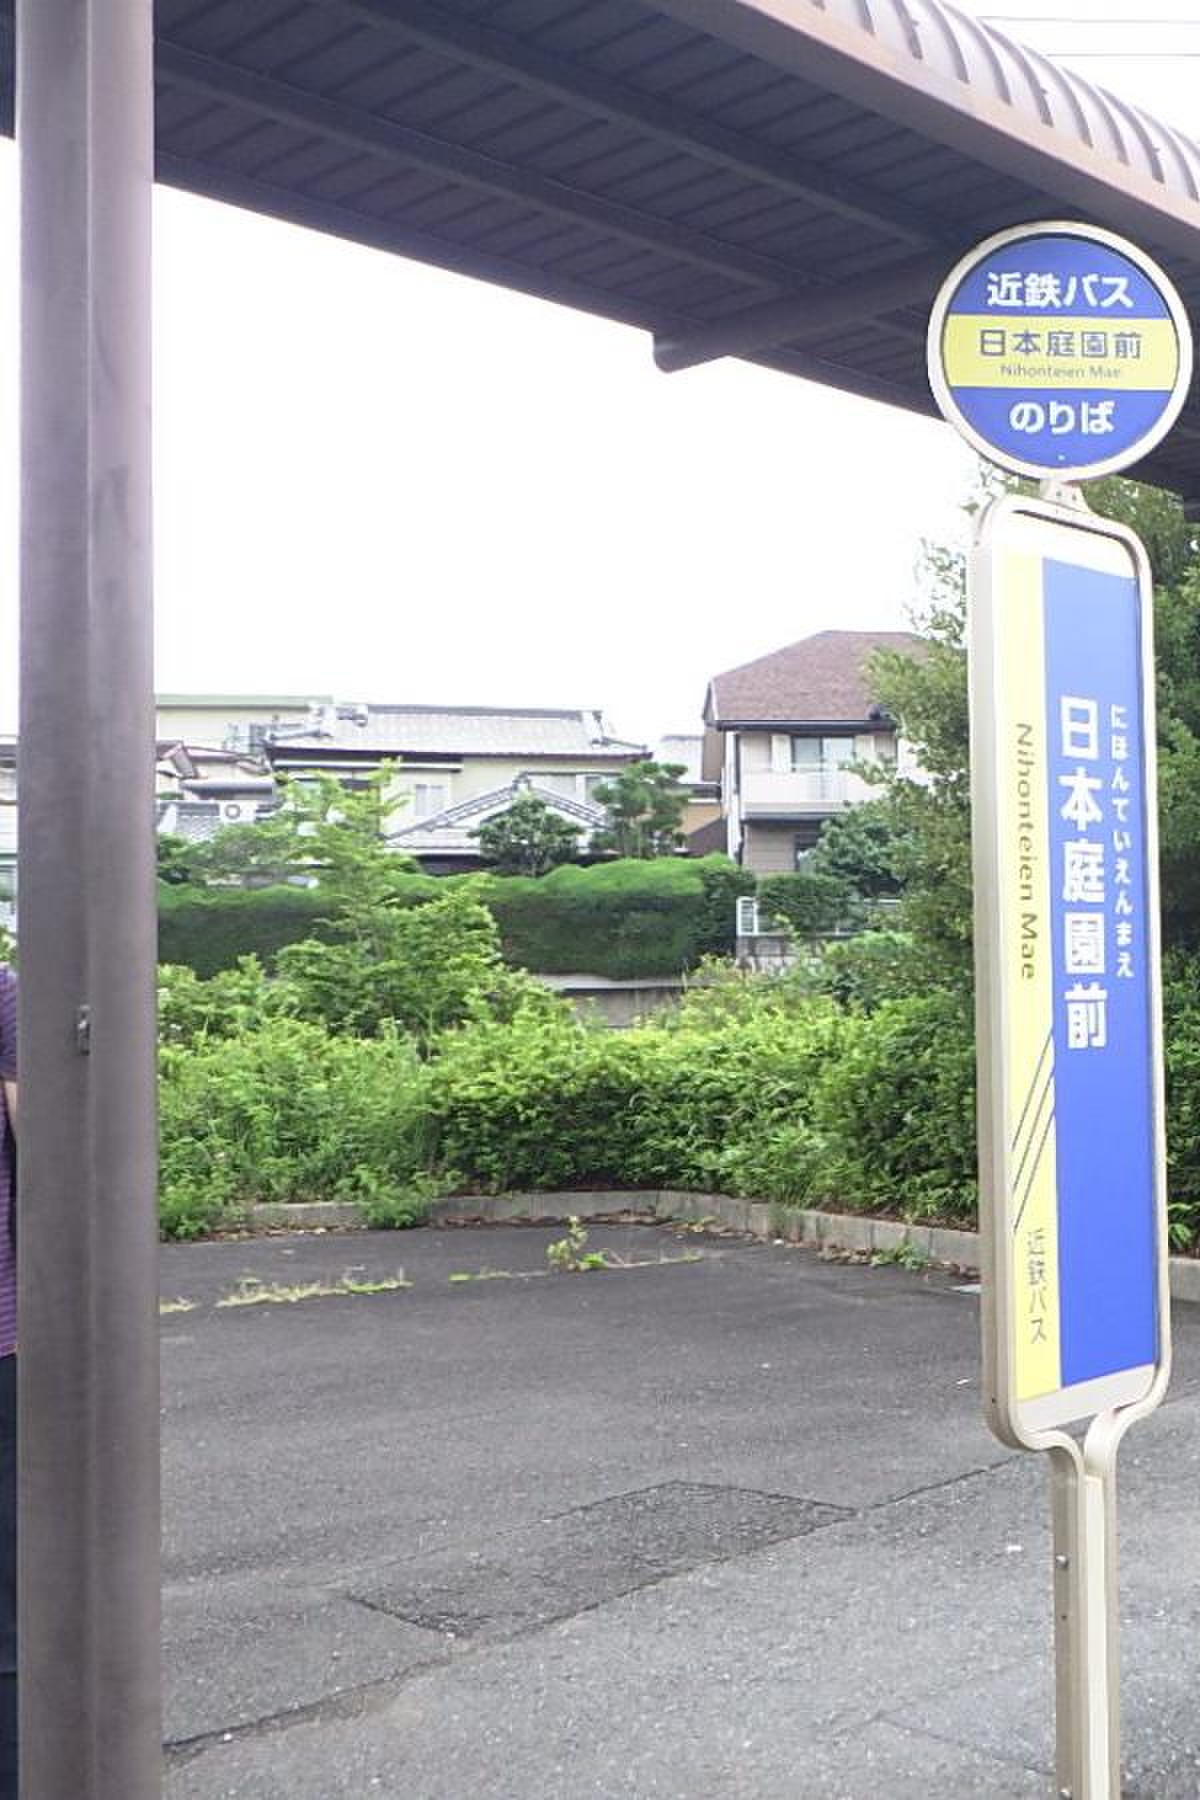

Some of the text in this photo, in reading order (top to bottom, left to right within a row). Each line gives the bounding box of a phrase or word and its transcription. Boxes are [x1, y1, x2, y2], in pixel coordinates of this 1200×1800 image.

[986, 271, 1135, 308] 近鉄バス
[979, 329, 1143, 359] 日本庭園前
[1000, 365, 1121, 379] Nihonteien Mae
[1009, 401, 1115, 435] のりば
[1015, 722, 1039, 980] Nihonteien Mae
[1057, 694, 1108, 1050] 日本庭園前
[1110, 703, 1134, 979] にほんていえんまえ
[1026, 1227, 1048, 1344] 近鉄バス
